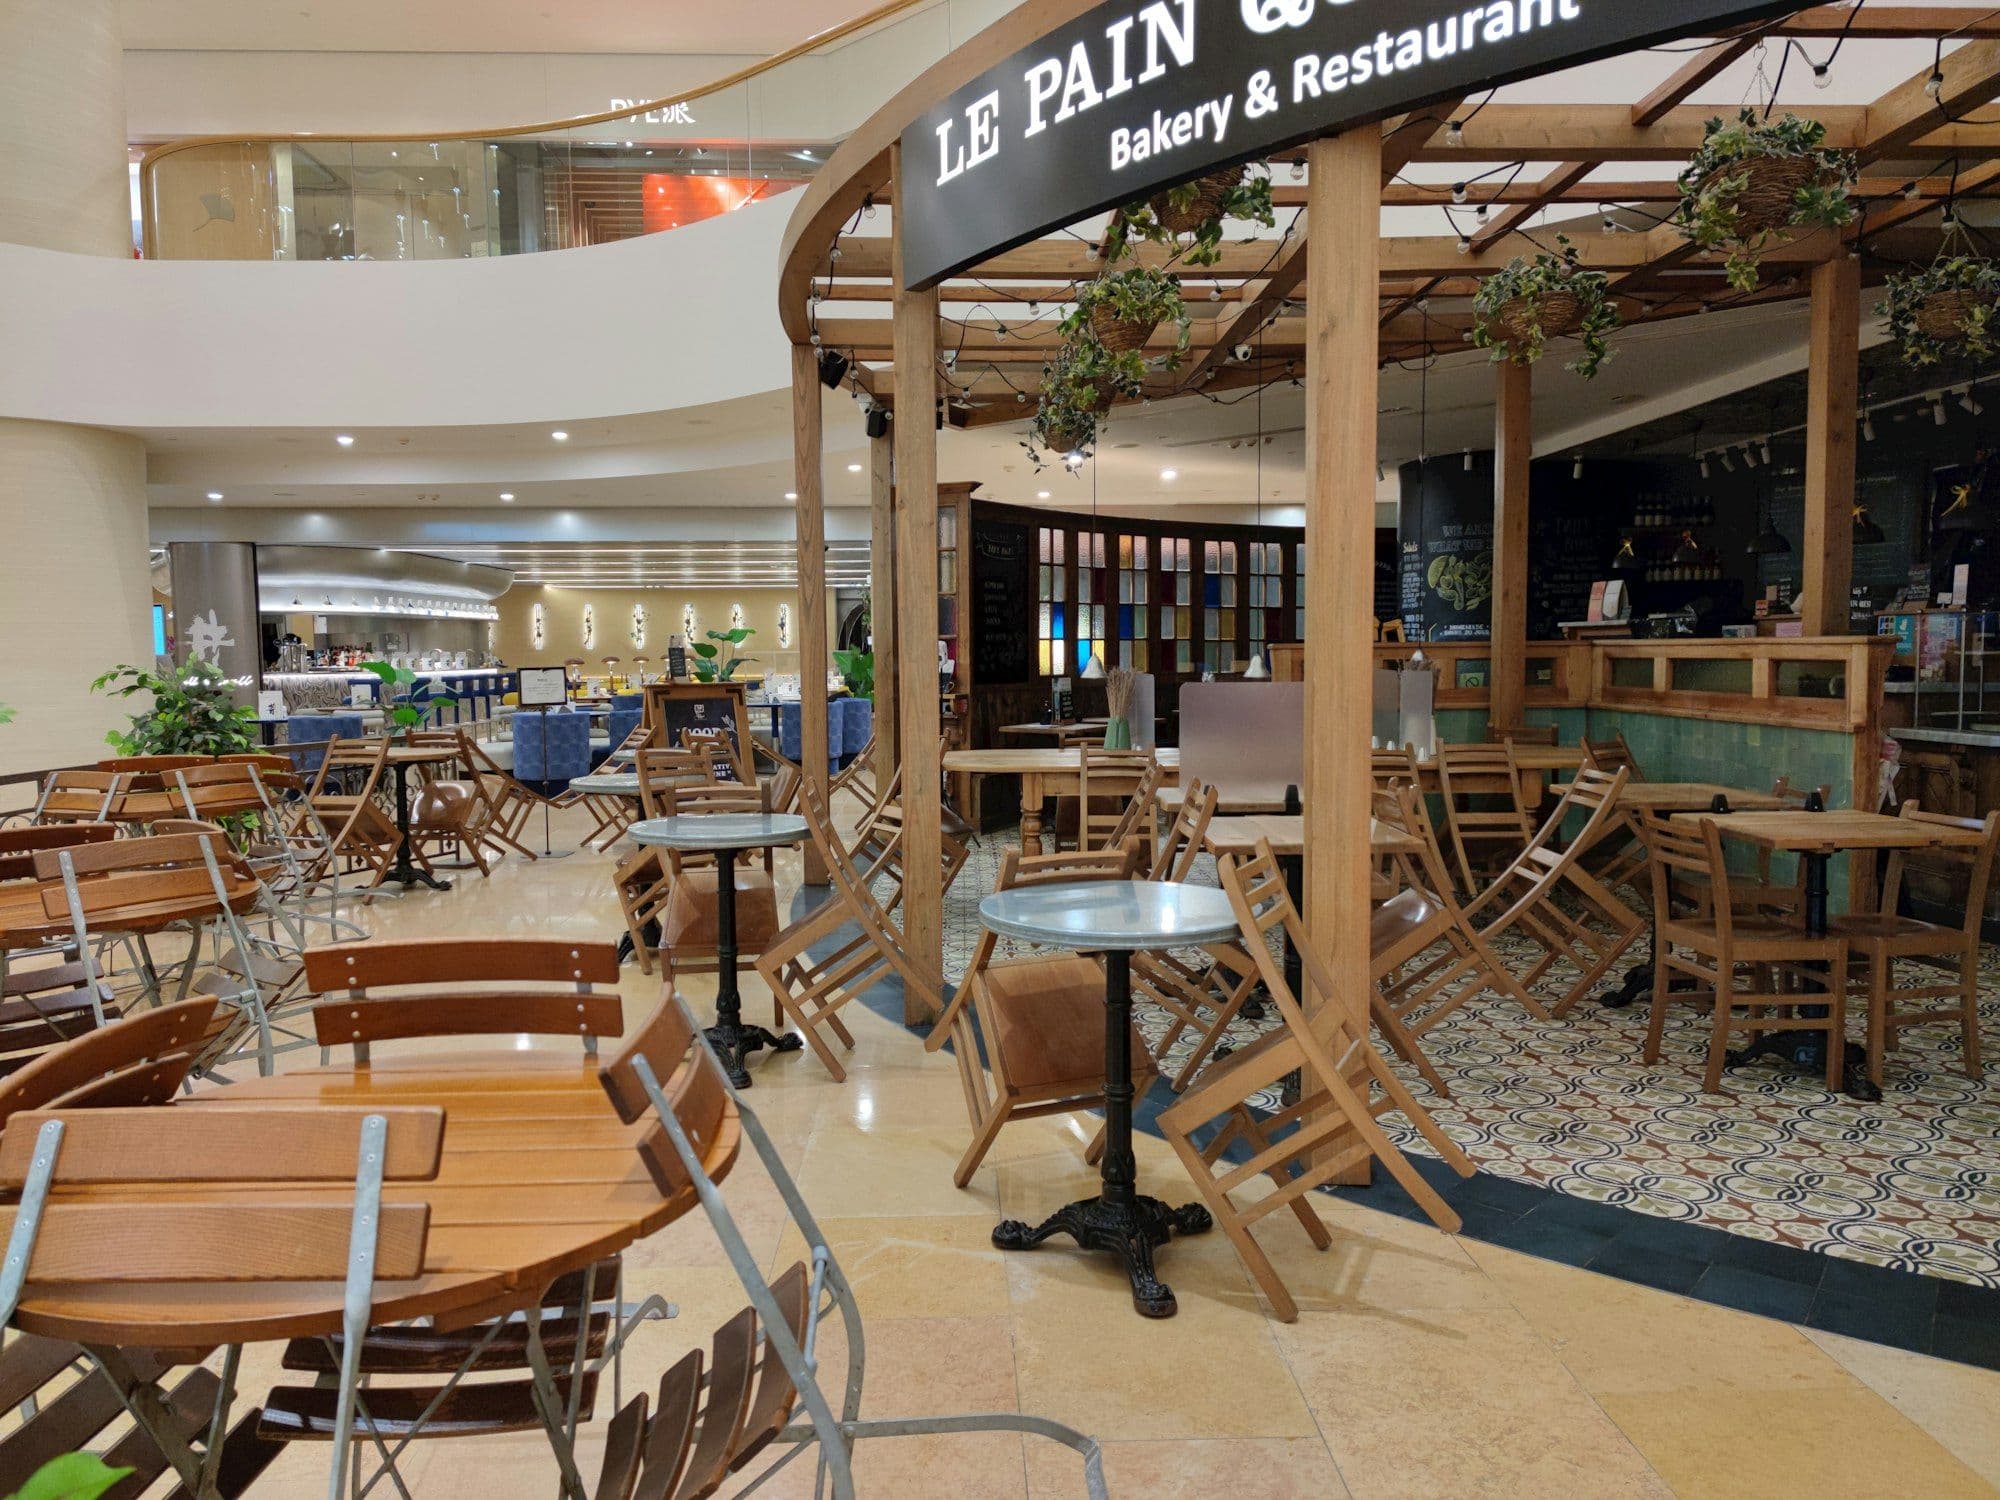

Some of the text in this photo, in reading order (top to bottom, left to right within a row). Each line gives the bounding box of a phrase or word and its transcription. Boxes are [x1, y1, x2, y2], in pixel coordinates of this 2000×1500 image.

[935, 0, 1195, 184] LE PAIN
[1111, 93, 1233, 171] Bakery
[1244, 69, 1279, 119] &
